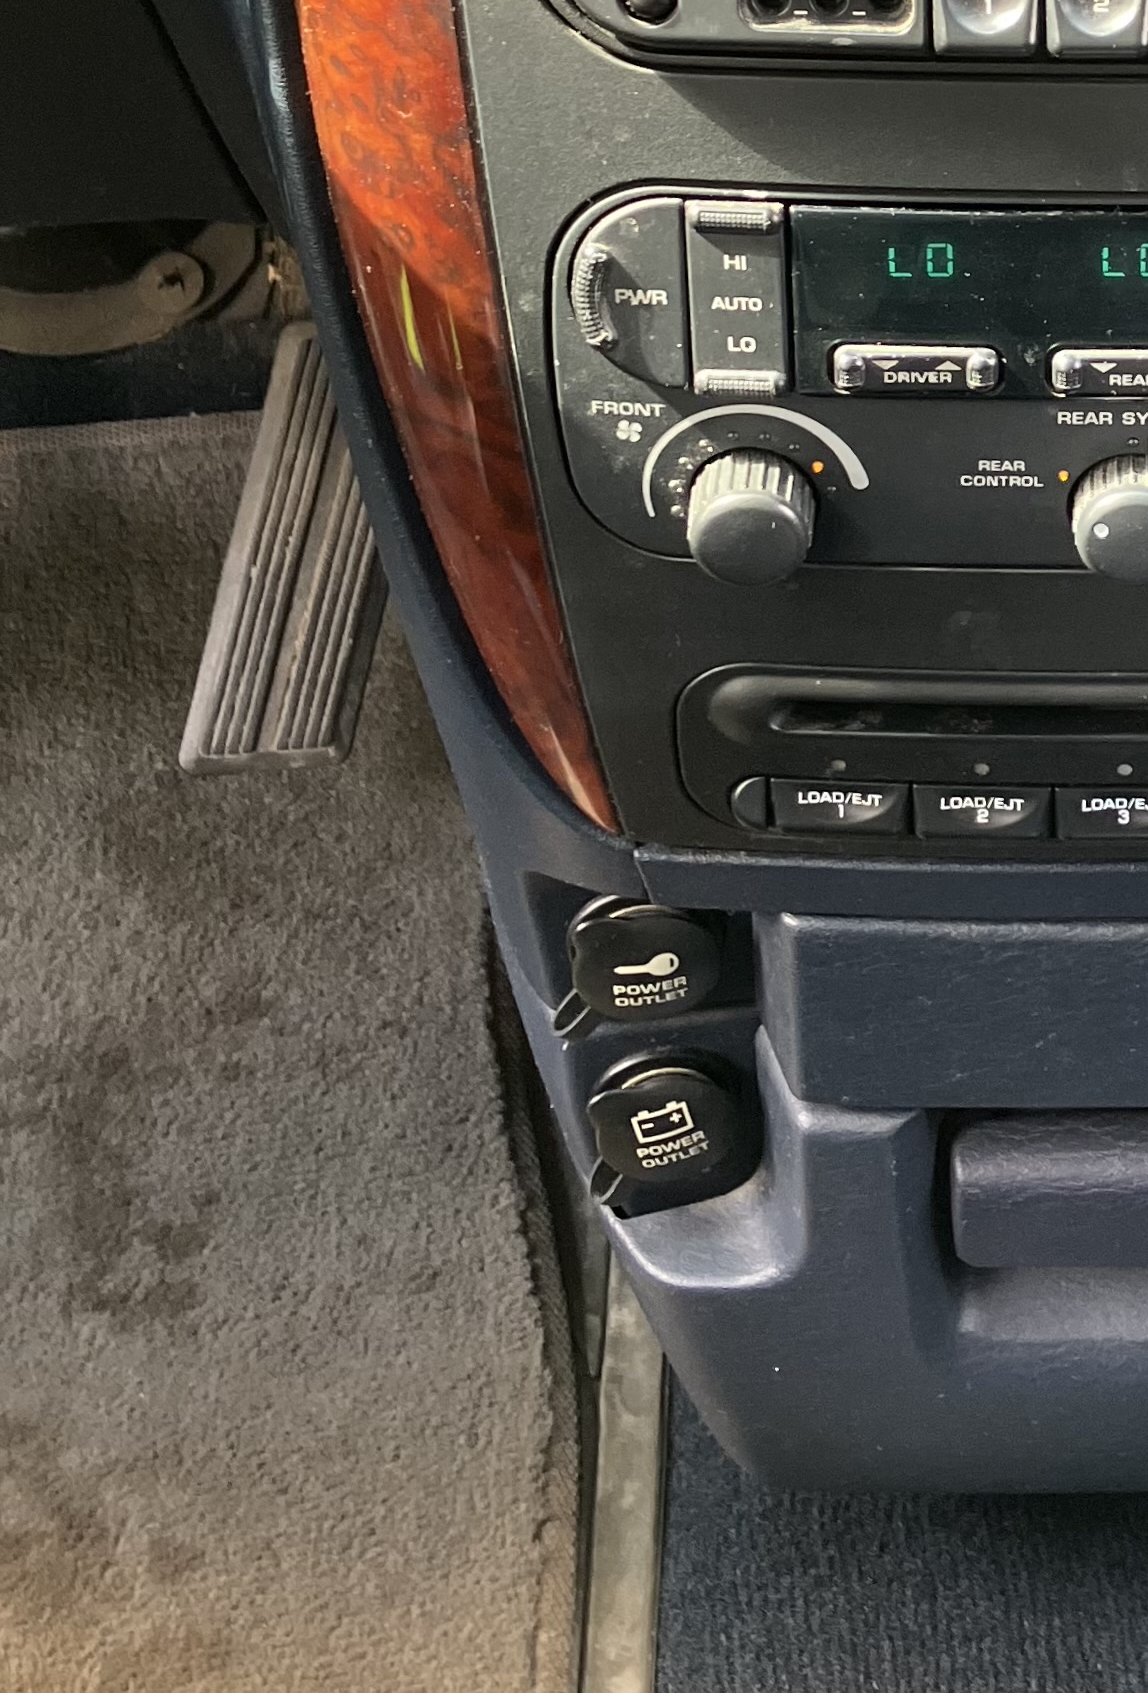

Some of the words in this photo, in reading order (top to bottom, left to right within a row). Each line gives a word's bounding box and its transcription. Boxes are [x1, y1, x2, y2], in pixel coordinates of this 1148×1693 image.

[722, 254, 747, 271] HI
[614, 288, 668, 306] PWR
[711, 296, 763, 312] AUTO
[727, 336, 757, 353] LO
[883, 370, 953, 384] DRIVER
[590, 400, 666, 417] FRONT
[1056, 411, 1113, 425] REAR
[978, 460, 1025, 472] REAR
[959, 474, 1044, 488] CONTROL
[798, 790, 883, 807] LOAD/EJT
[939, 795, 1025, 812] LOAD/EJT
[837, 804, 845, 819] 1
[976, 809, 990, 823] 2
[1117, 810, 1130, 825] 3
[611, 976, 688, 997] POWER
[614, 987, 689, 1008] OUTLET
[635, 1130, 706, 1159] POWER
[641, 1140, 710, 1169] OUTLET
